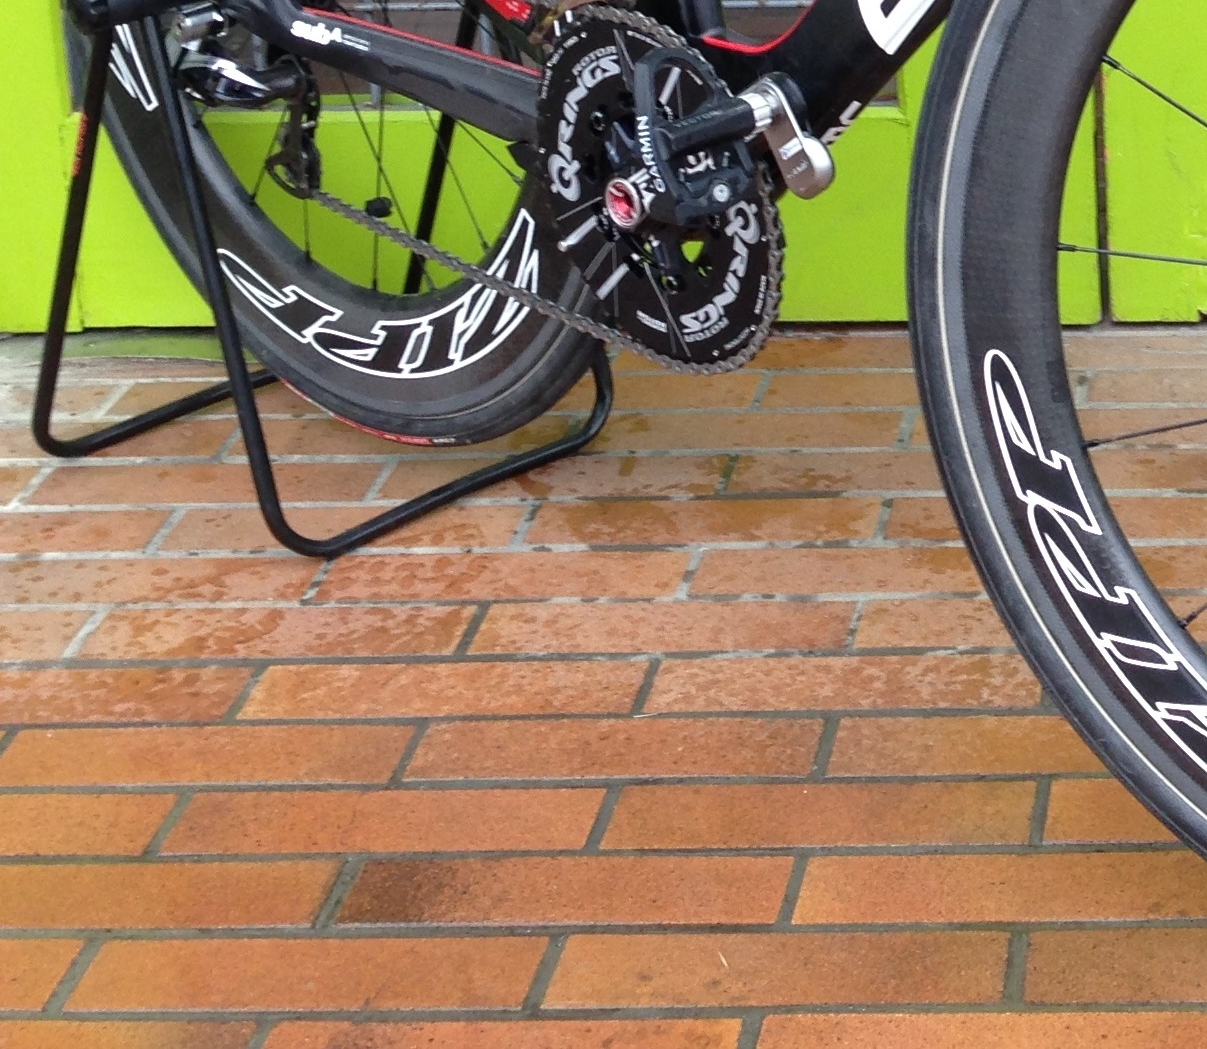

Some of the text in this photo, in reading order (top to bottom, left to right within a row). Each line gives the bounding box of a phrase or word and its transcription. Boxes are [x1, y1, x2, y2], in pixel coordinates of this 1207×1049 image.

[572, 46, 618, 76] ROTOR
[636, 115, 666, 193] GARMIN
[217, 208, 539, 378] ZIPP
